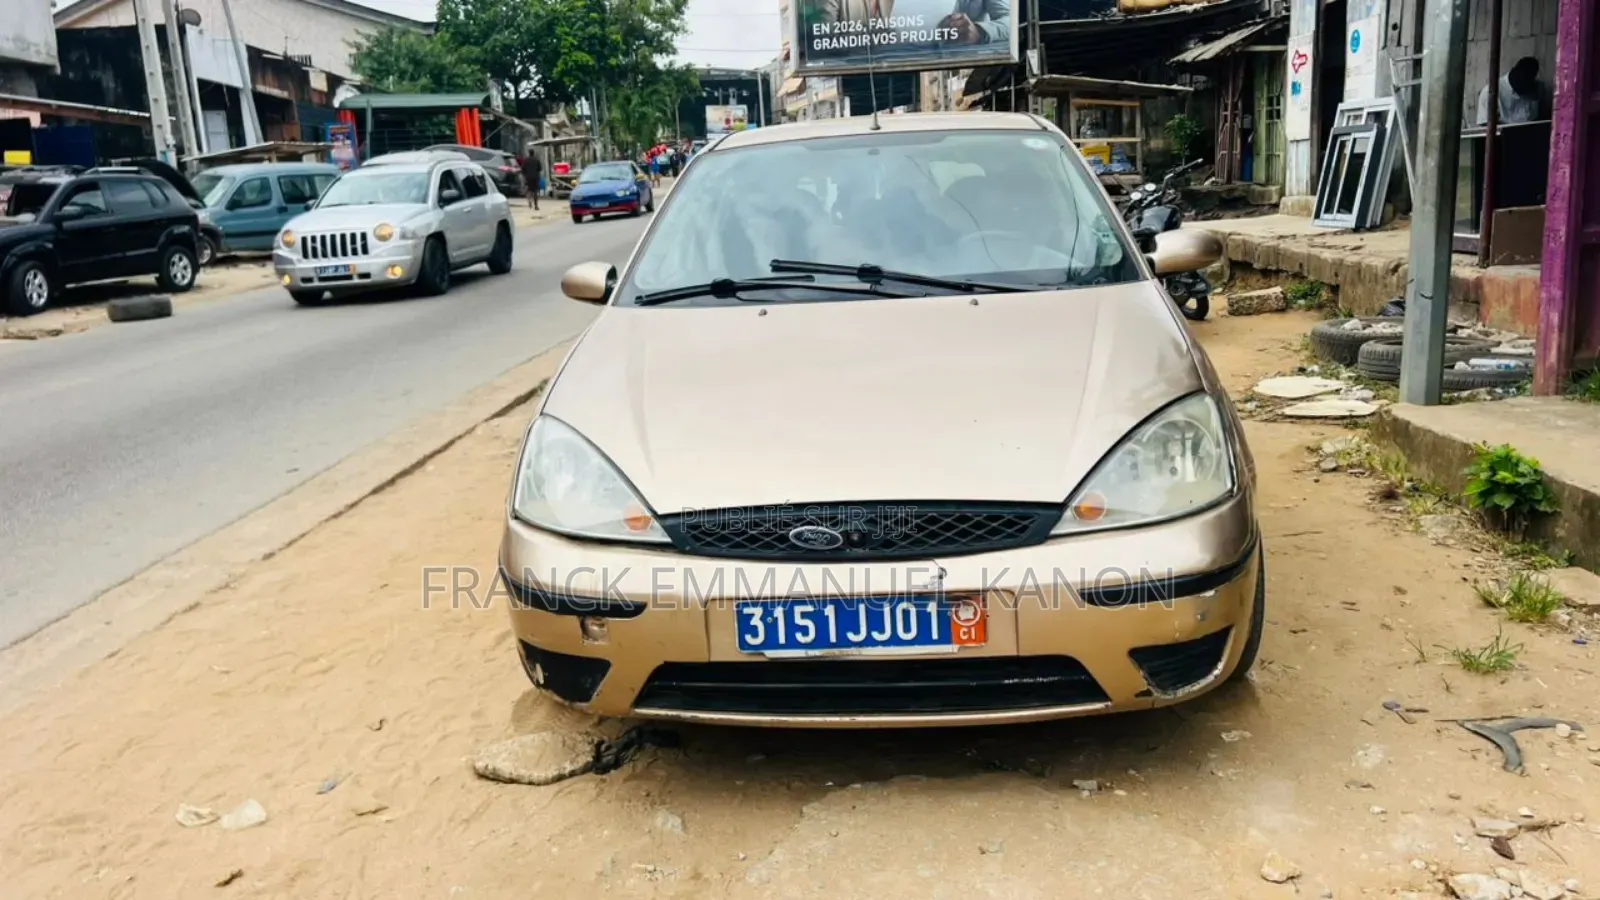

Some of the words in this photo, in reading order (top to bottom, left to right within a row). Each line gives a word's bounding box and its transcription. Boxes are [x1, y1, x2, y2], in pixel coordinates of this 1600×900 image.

[813, 23, 831, 36] EN
[833, 20, 867, 34] 2026,
[869, 14, 925, 31] FAISONS
[813, 35, 871, 50] GRANDIR
[872, 32, 897, 45] VOS
[900, 27, 959, 43] PROJETS
[742, 601, 939, 646] 3151JJ01
